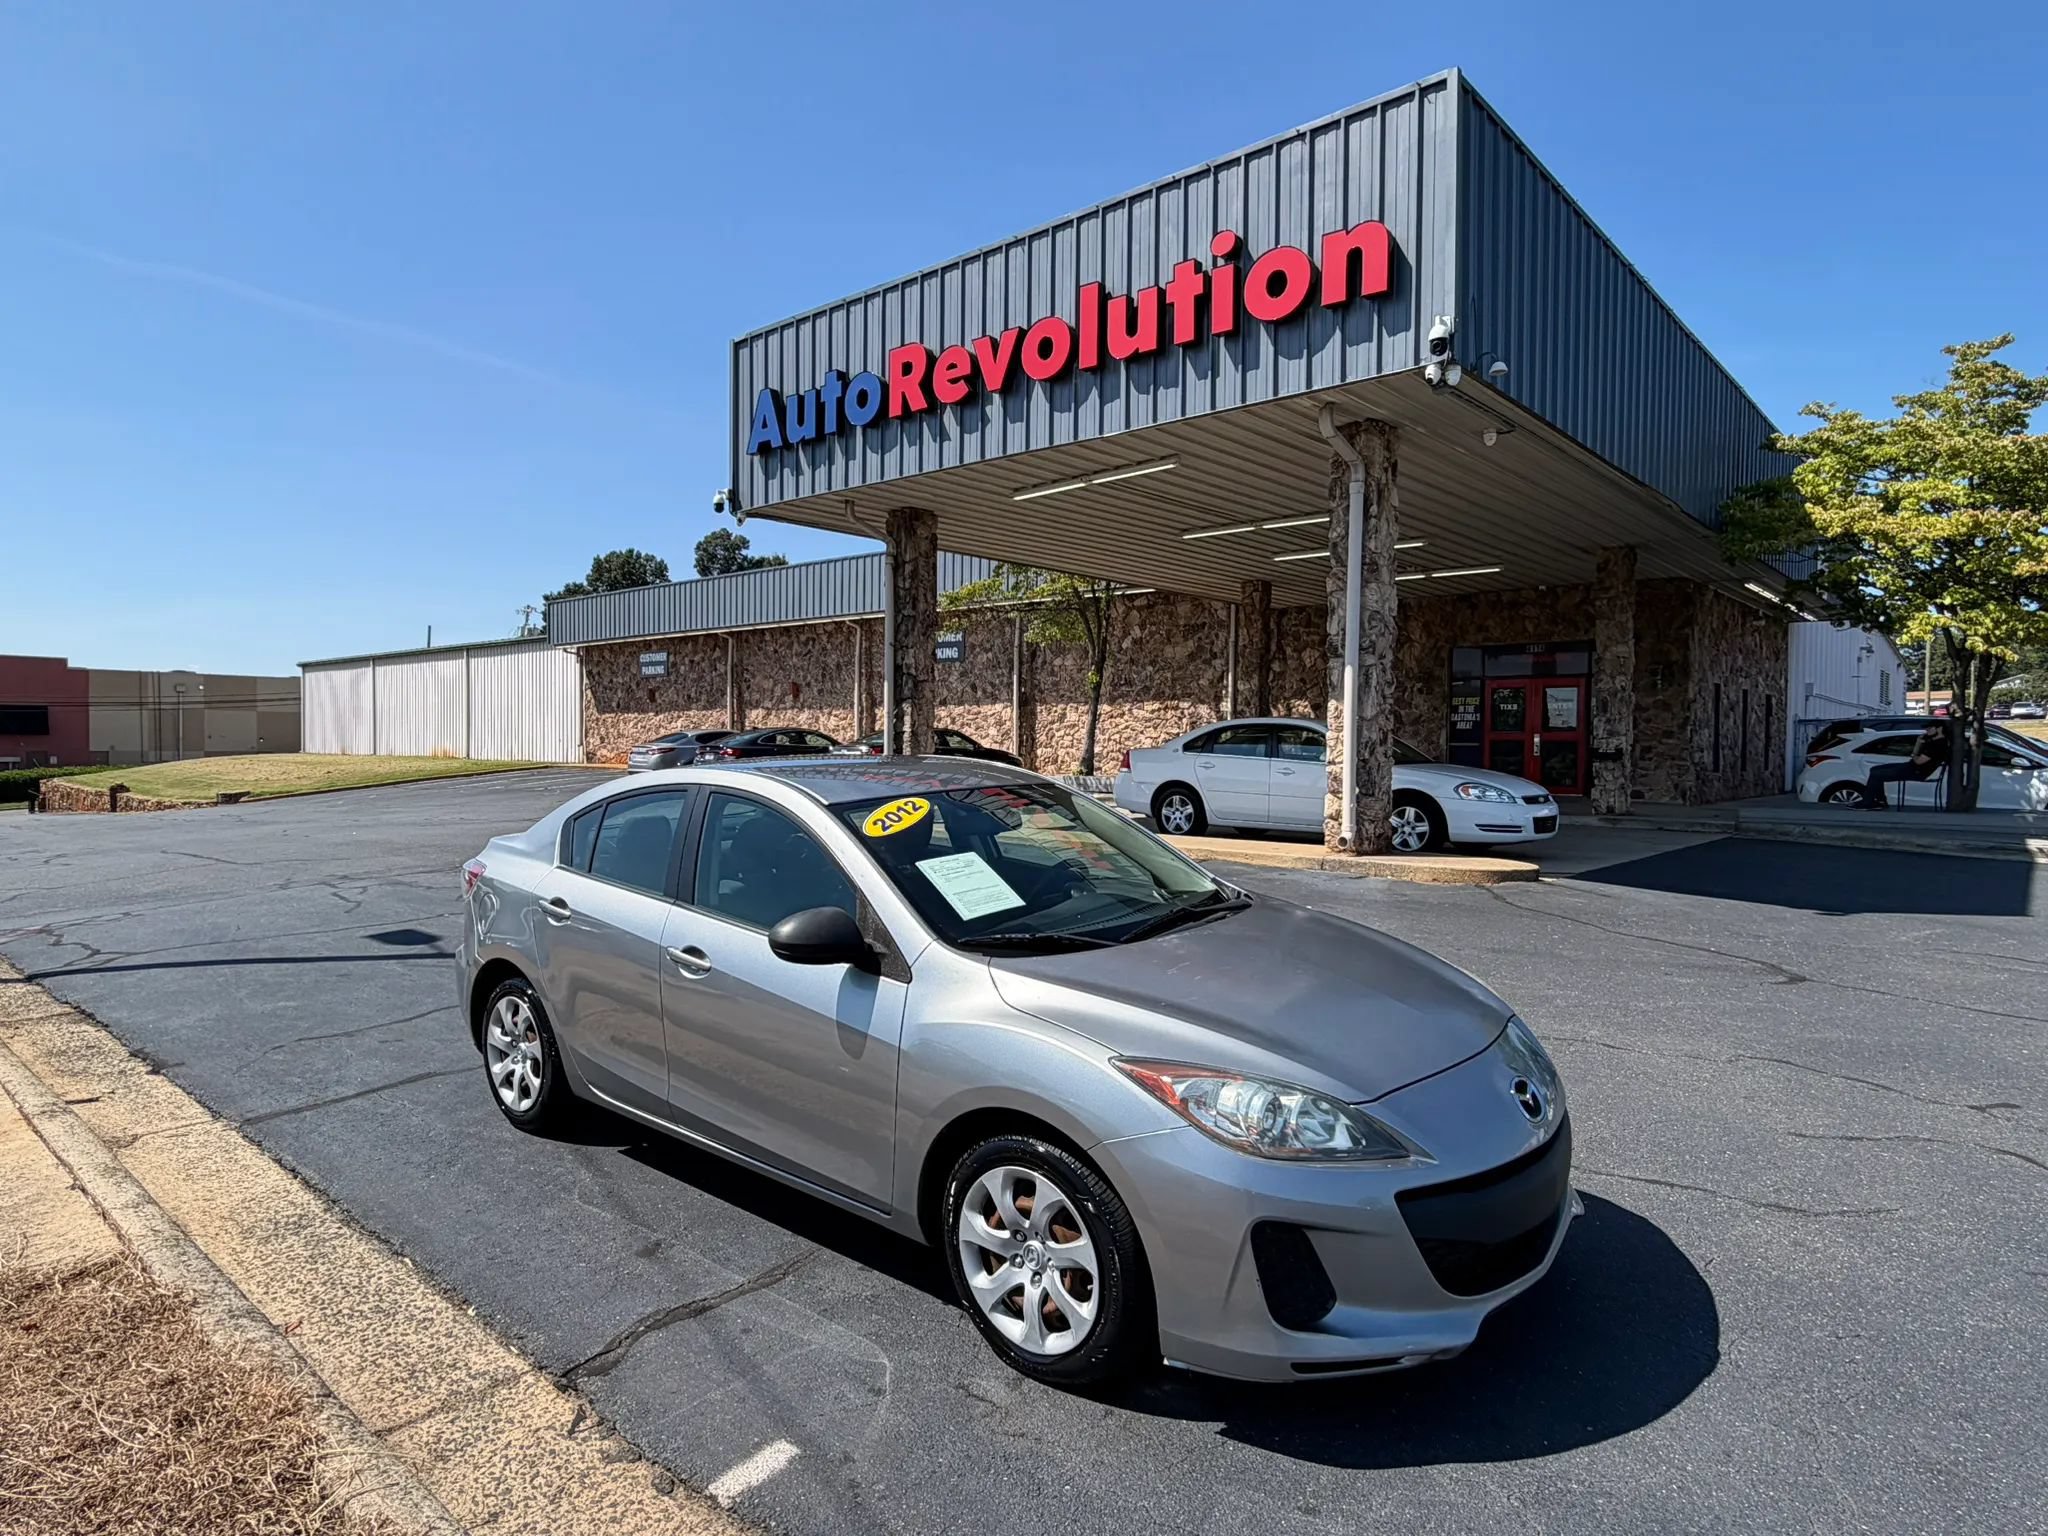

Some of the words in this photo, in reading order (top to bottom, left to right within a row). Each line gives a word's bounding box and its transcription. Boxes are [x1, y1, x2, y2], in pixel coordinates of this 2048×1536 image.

[639, 652, 667, 663] CUSTOMER
[935, 647, 959, 659] KING
[641, 665, 665, 676] PARKING
[872, 800, 923, 832] 2012
